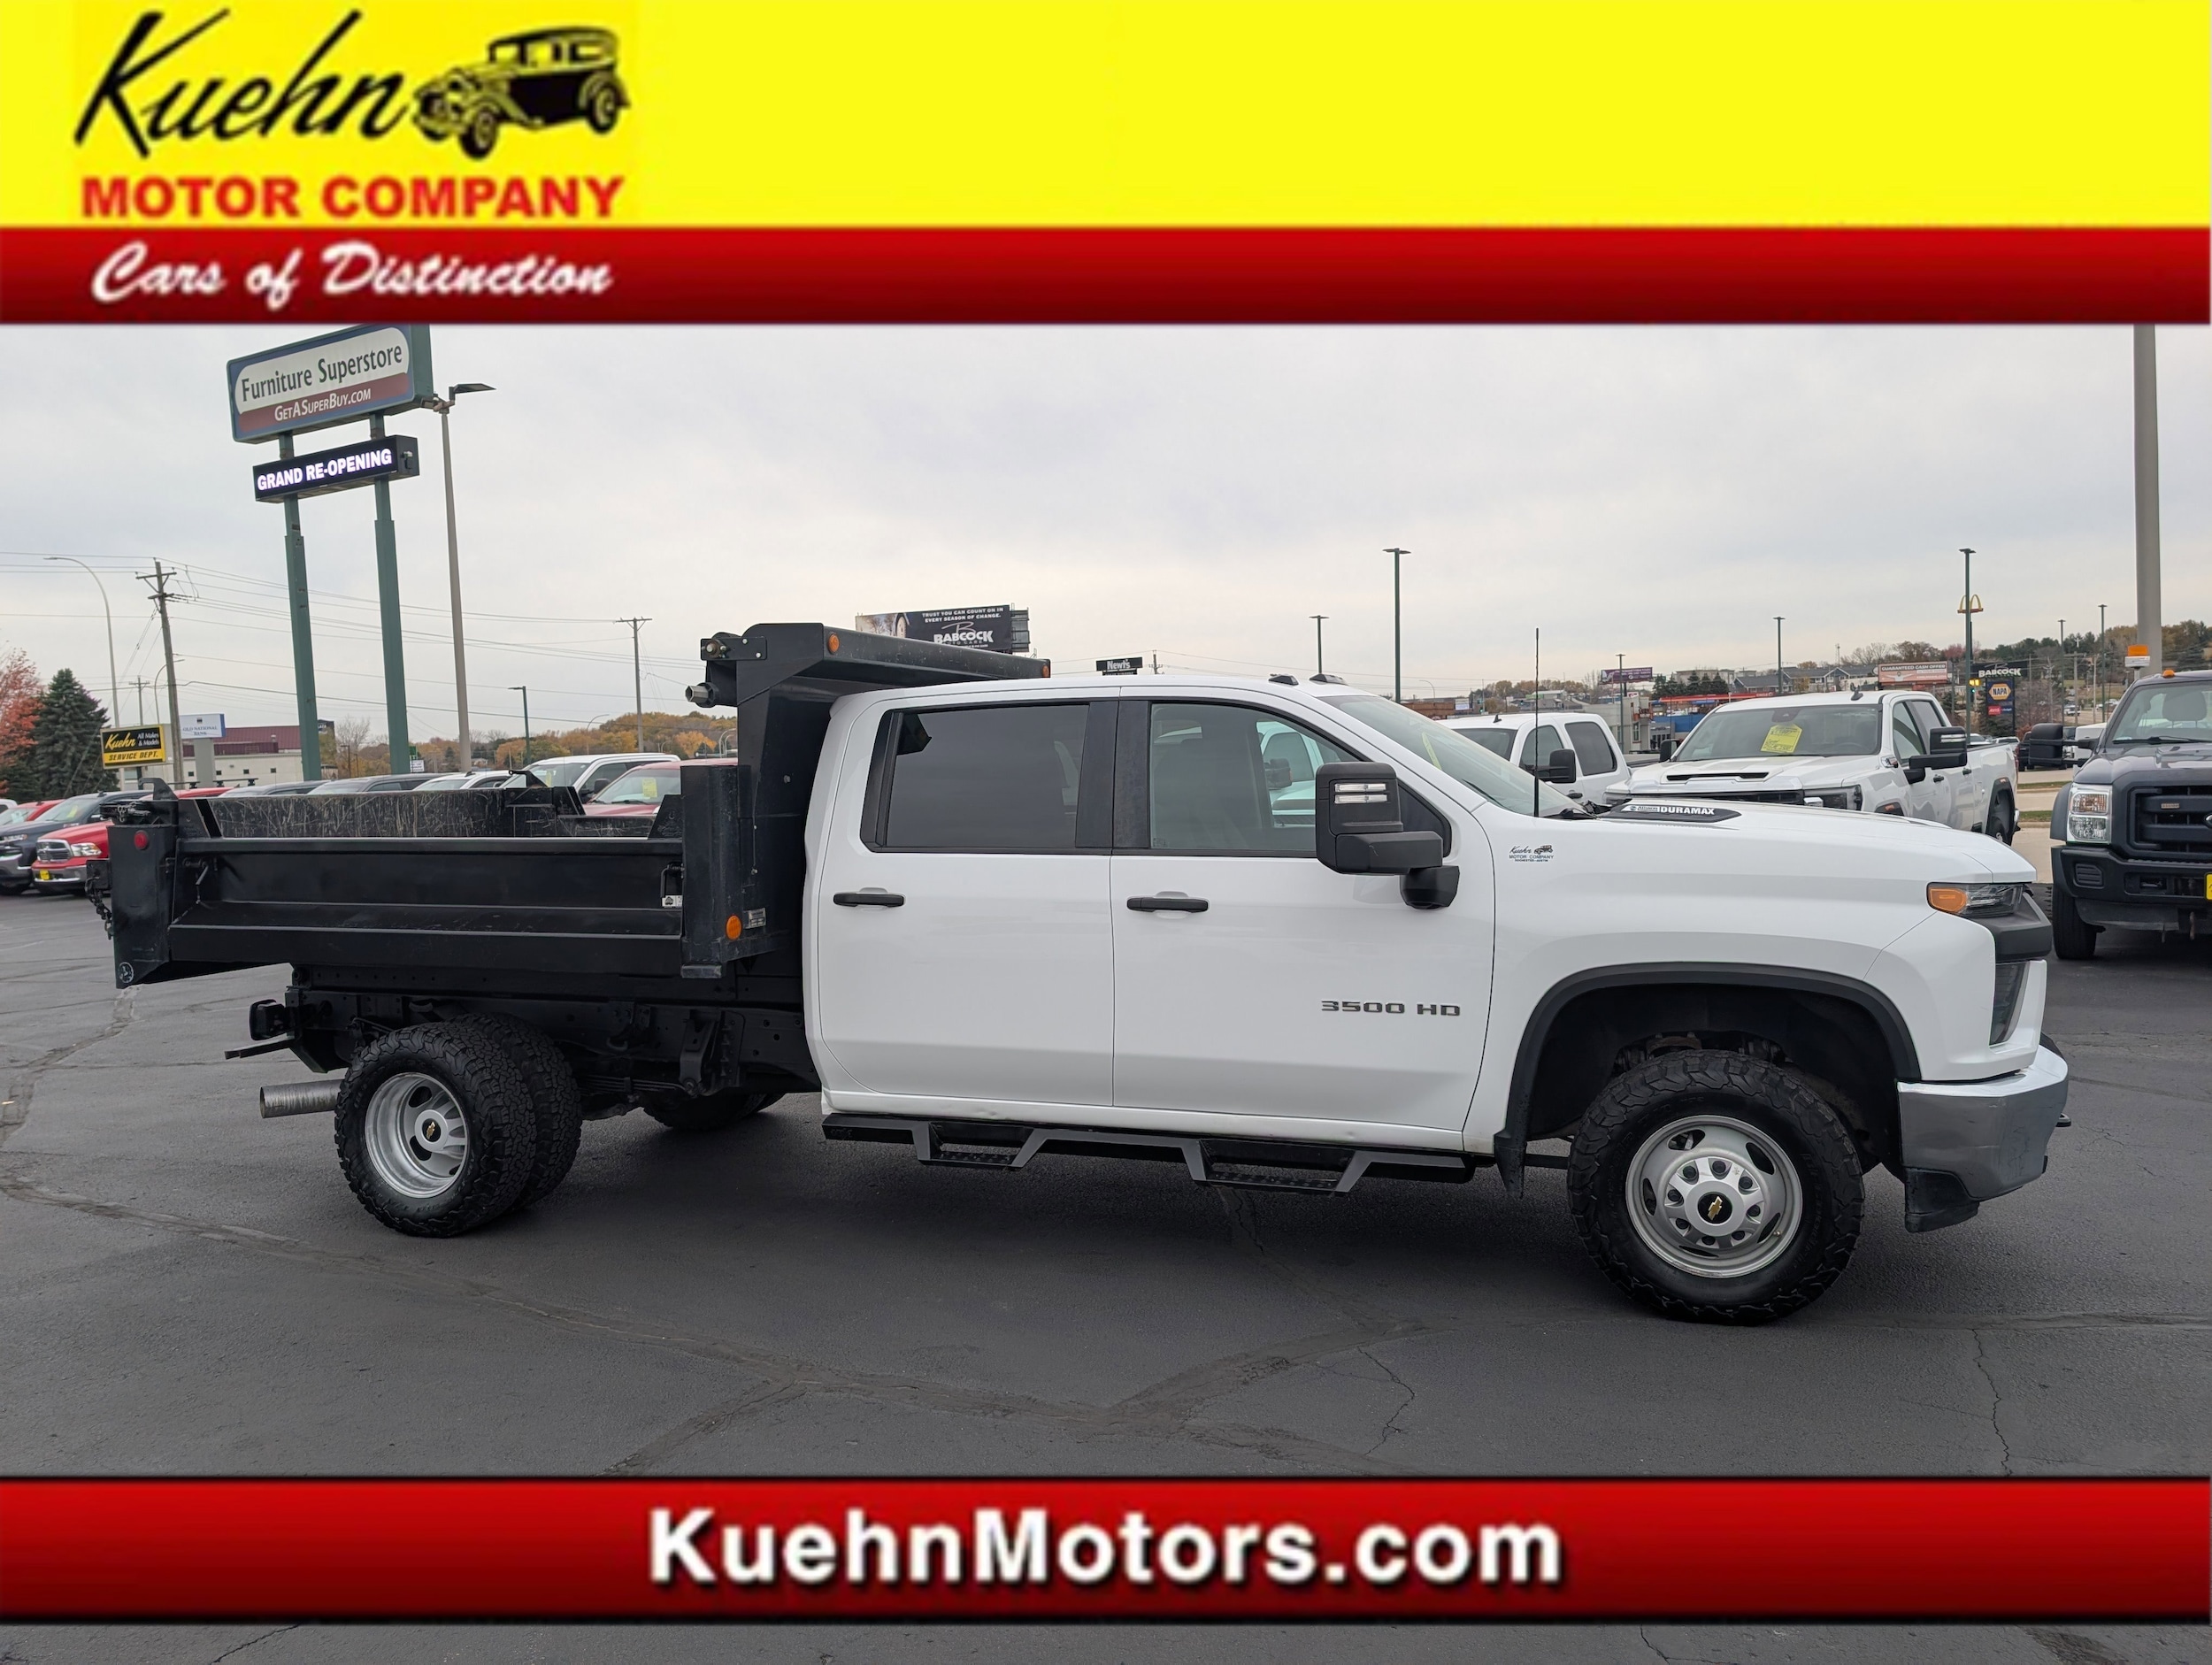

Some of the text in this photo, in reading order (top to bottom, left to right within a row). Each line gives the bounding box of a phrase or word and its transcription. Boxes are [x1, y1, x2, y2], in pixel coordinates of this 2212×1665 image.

[242, 344, 402, 402] Furniture Superstore
[257, 449, 392, 491] GRAND RE-OPENING
[933, 630, 994, 644] BABCOCK
[1978, 668, 2021, 678] BABCOCK
[105, 732, 136, 750] Kuehn
[109, 752, 136, 761] SERVICE
[1321, 1001, 1460, 1017] 3500 HD
